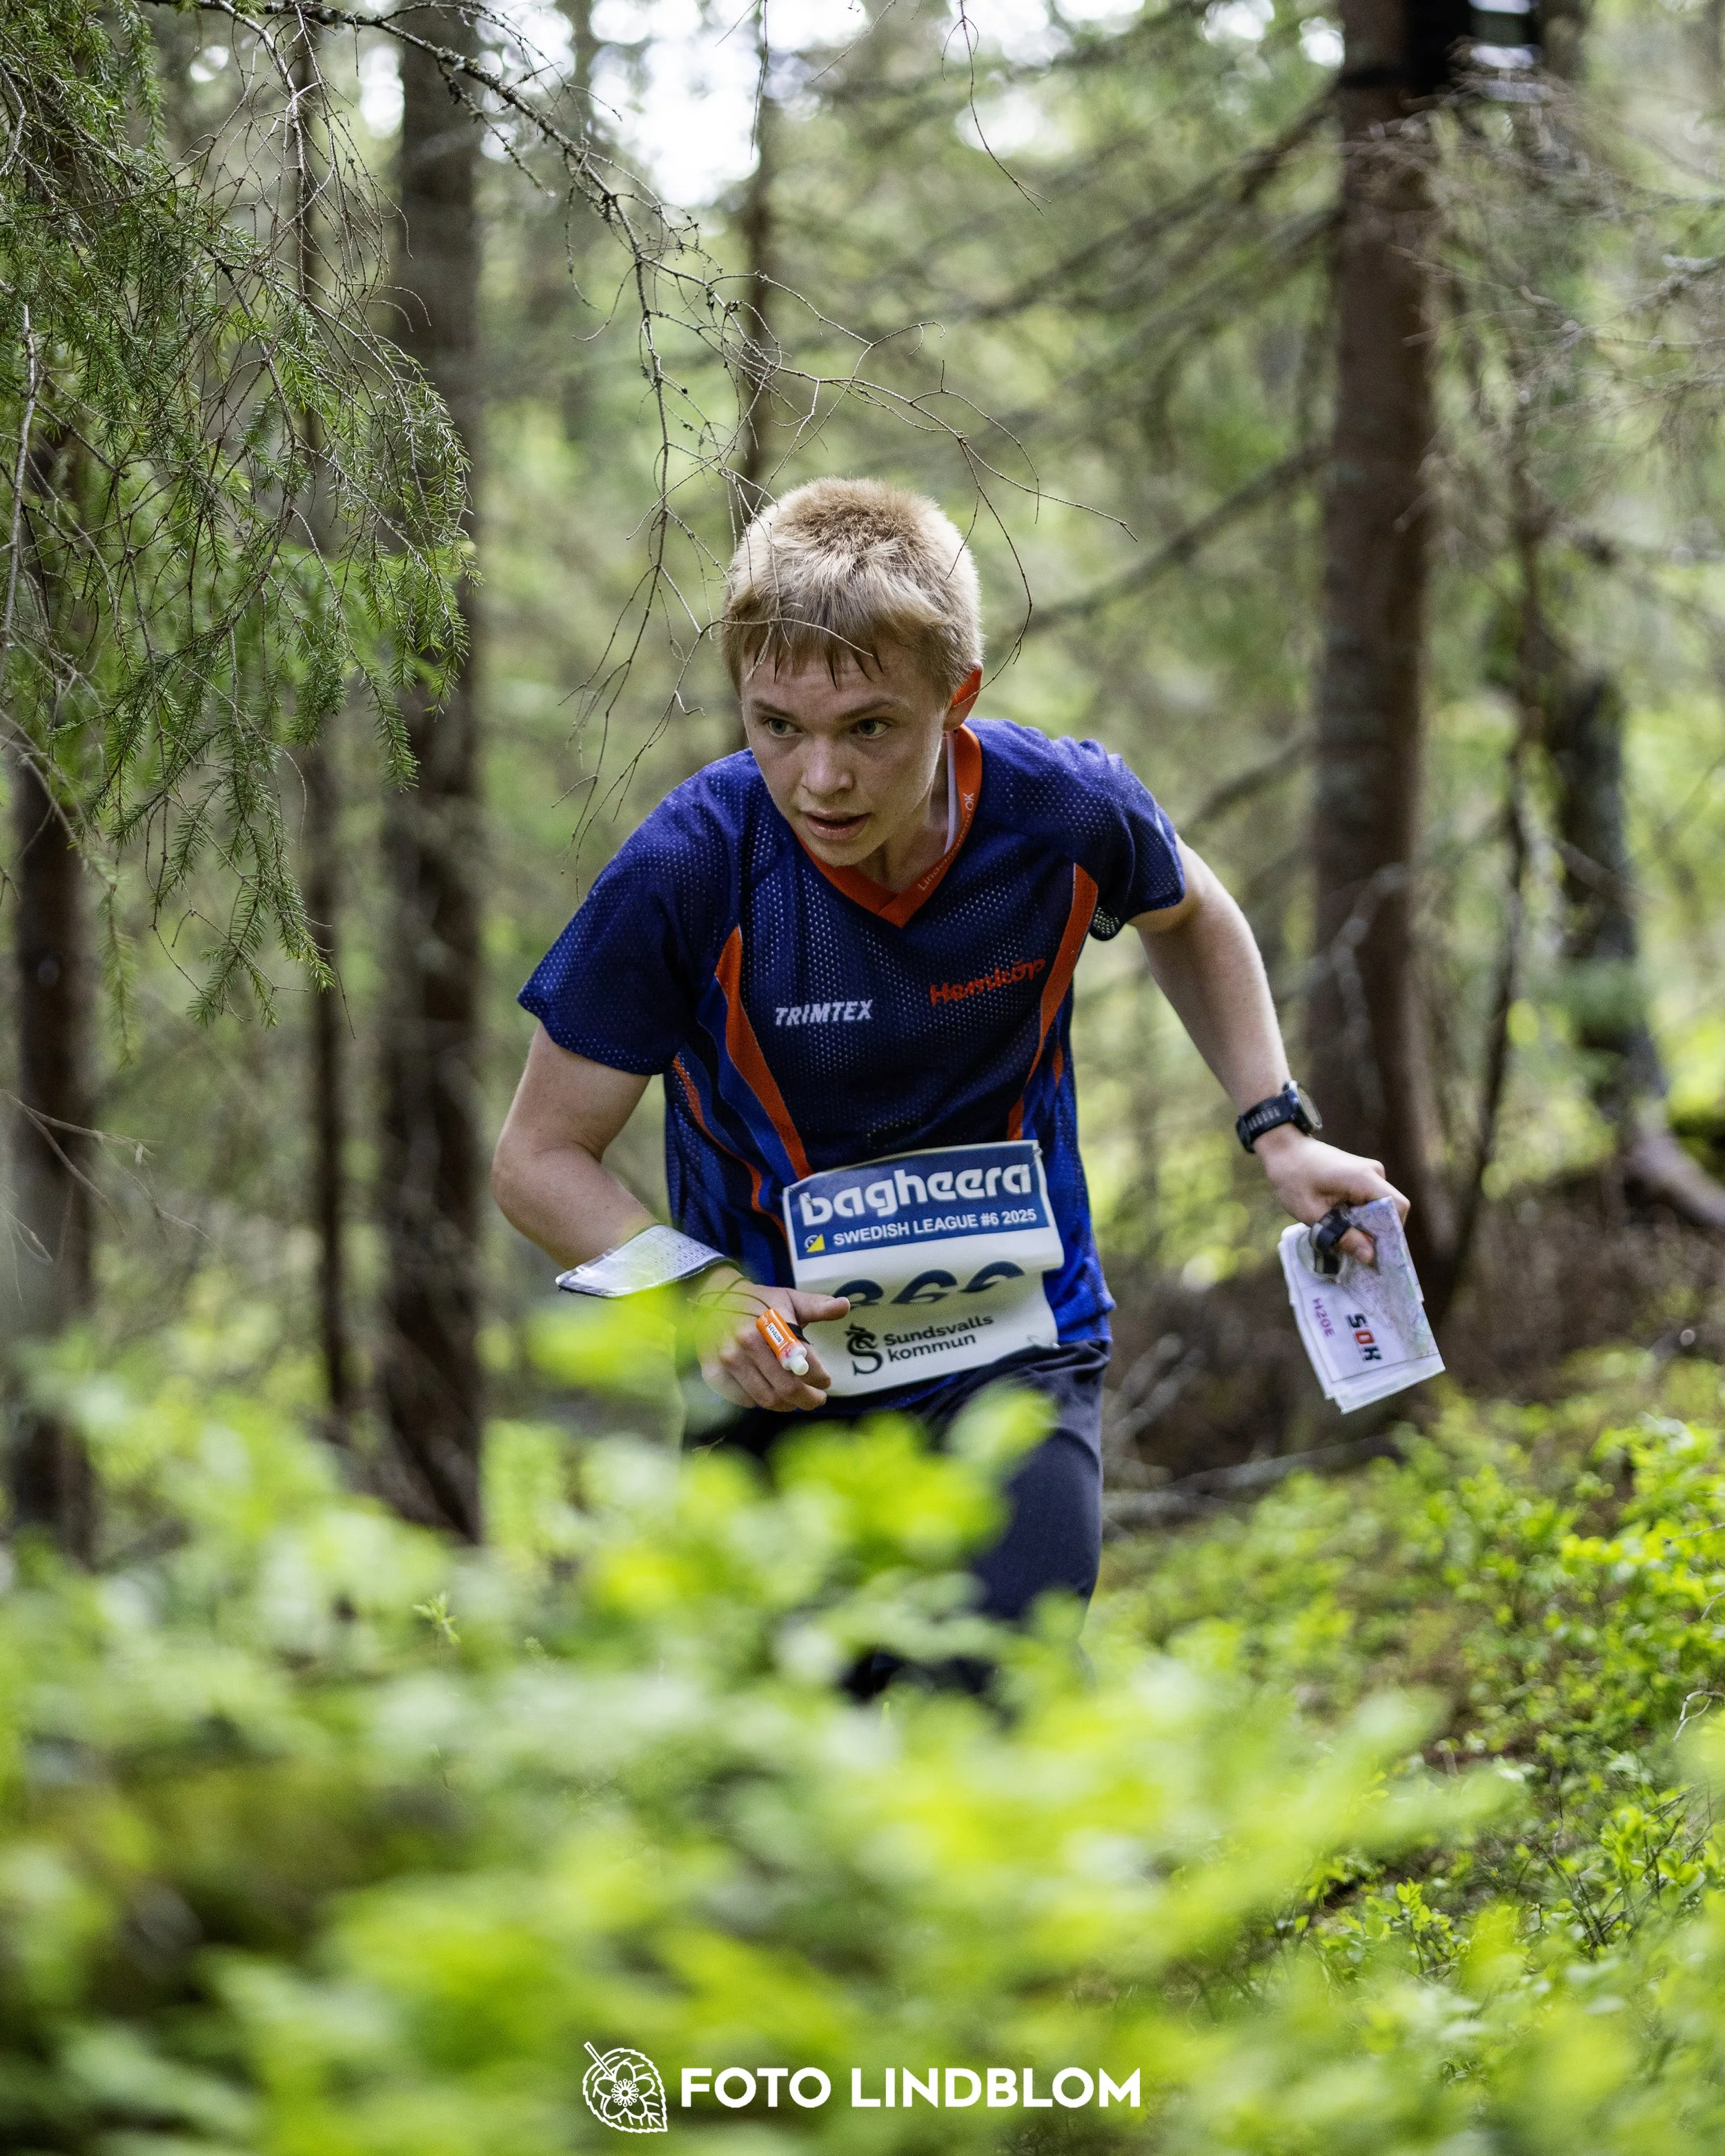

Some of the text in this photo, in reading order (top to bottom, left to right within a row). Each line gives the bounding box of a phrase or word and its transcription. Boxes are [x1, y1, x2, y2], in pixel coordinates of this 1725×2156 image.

[963, 792, 974, 811] OK
[930, 958, 1045, 1006] Hemköp
[774, 999, 876, 1027] TRIMTEX
[798, 1163, 1032, 1227] bagheera
[833, 1208, 1038, 1246] SWEDISH LEAGUE #6 2025
[883, 1314, 994, 1347] Sundsvalls
[1312, 1296, 1335, 1337] H20E
[887, 1334, 977, 1363] kommun
[1347, 1312, 1382, 1362] SOK
